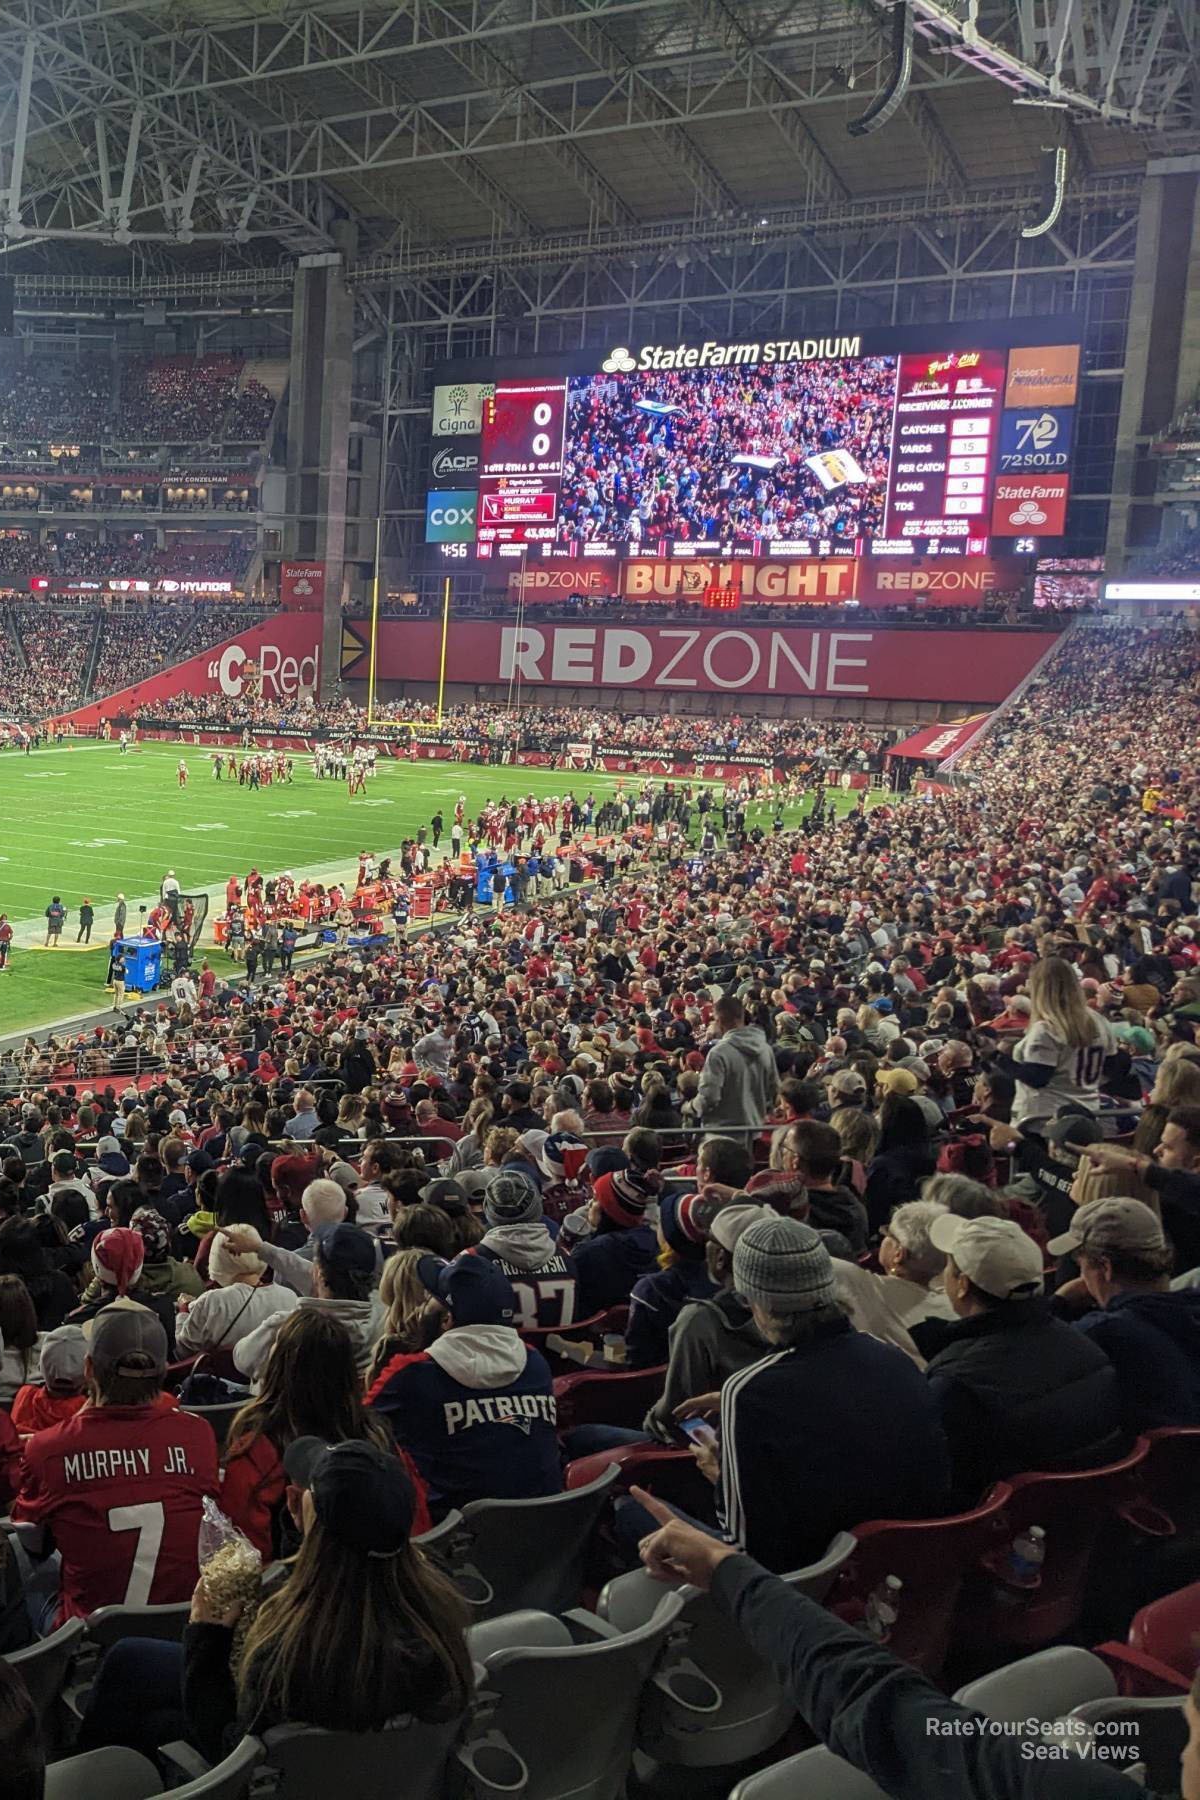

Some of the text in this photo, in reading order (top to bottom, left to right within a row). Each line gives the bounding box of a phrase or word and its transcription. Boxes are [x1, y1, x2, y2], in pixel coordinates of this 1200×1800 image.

[763, 337, 860, 361] STADIUM
[534, 403, 551, 426] 0
[439, 418, 475, 433] Cigna
[901, 422, 975, 435] CATCHES 3
[532, 433, 550, 456] 0
[899, 442, 975, 454] YARDS 15
[439, 455, 478, 467] ACP
[897, 461, 971, 473] PER CATCH 5
[896, 482, 925, 492] LONG
[503, 497, 536, 505] MURRAY
[894, 501, 915, 512] TDS
[430, 508, 475, 526] COX
[440, 543, 468, 558] 4:56
[553, 549, 570, 557] FINAL
[641, 548, 658, 556] FINAL
[1015, 540, 1035, 553] 25
[180, 581, 232, 592] HYUNDAI
[508, 572, 602, 589] REDZONE
[625, 564, 712, 596] BUD
[876, 571, 996, 592] REDZONE
[499, 626, 873, 693] REDZONE
[260, 644, 319, 698] Red
[175, 987, 186, 999] 10
[1074, 1046, 1105, 1090] 10
[443, 1393, 558, 1436] PATRIOTS
[64, 1446, 195, 1484] MURPHY JR.
[108, 1501, 165, 1607] 7
